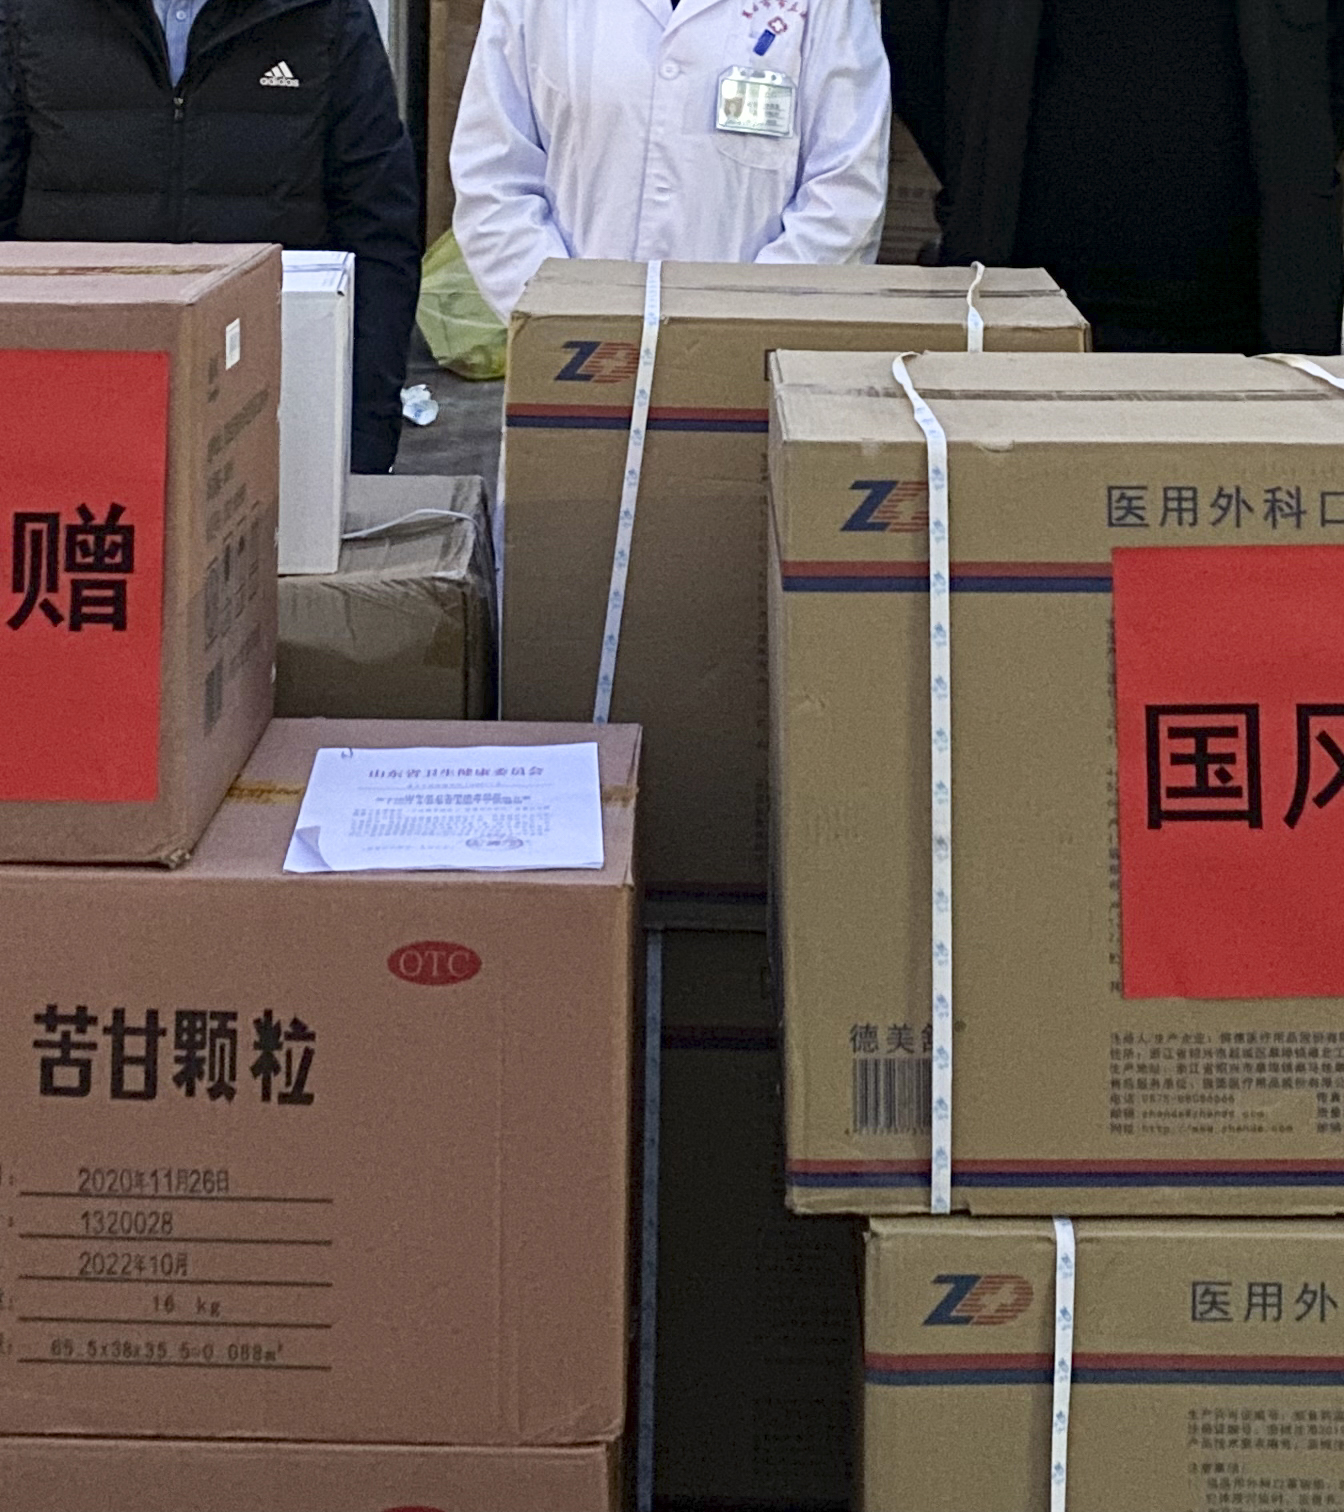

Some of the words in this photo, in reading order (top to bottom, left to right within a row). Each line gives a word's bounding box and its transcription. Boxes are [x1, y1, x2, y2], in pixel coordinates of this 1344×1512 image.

[259, 76, 299, 87] adidas
[399, 950, 471, 977] OTC
[33, 1003, 317, 1106] 苦甘颗粒
[78, 1168, 230, 1194] 2020年11月26日
[81, 1210, 174, 1236] 1320028
[78, 1252, 190, 1278] 2022年10月
[196, 1295, 222, 1318] kg
